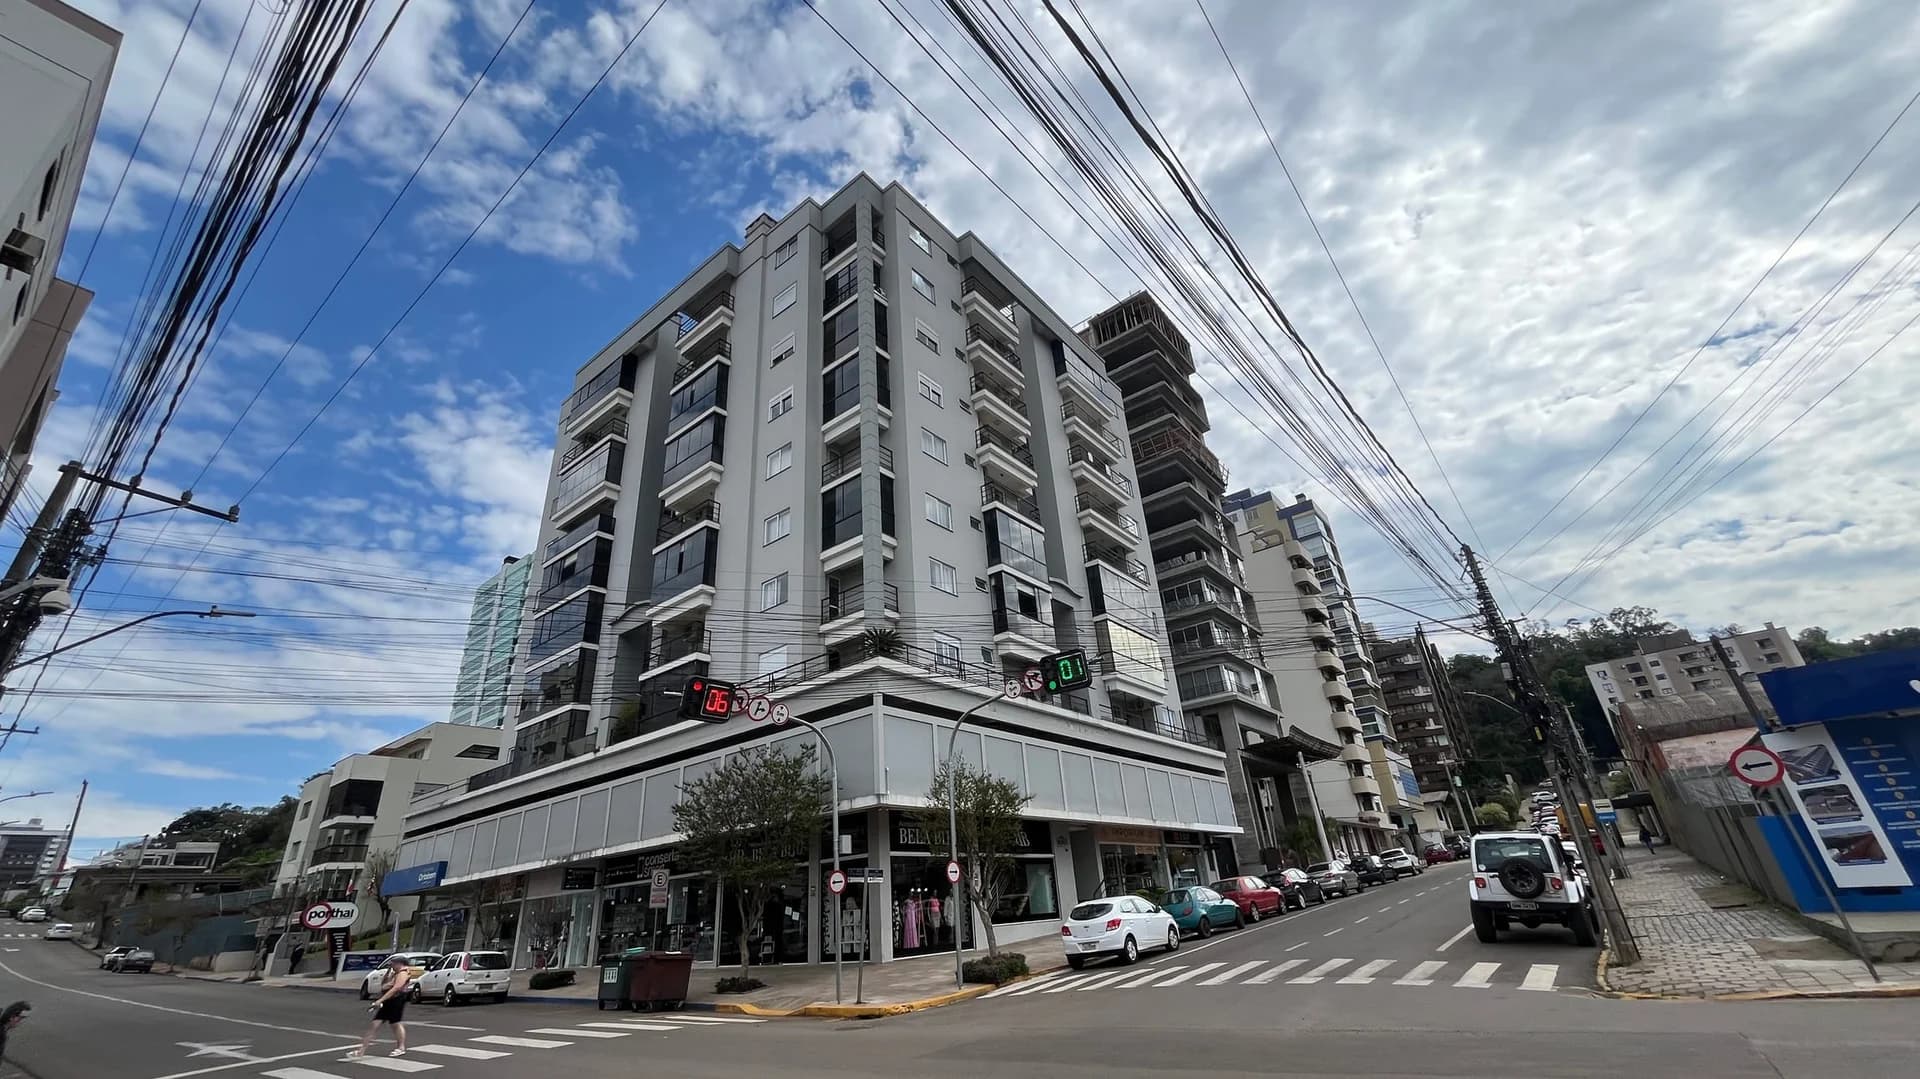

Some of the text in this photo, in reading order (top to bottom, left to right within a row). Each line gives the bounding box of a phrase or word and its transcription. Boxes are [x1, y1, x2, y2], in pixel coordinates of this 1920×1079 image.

[1060, 659, 1083, 680] 01
[706, 689, 729, 712] 06
[308, 908, 354, 921] porthal
